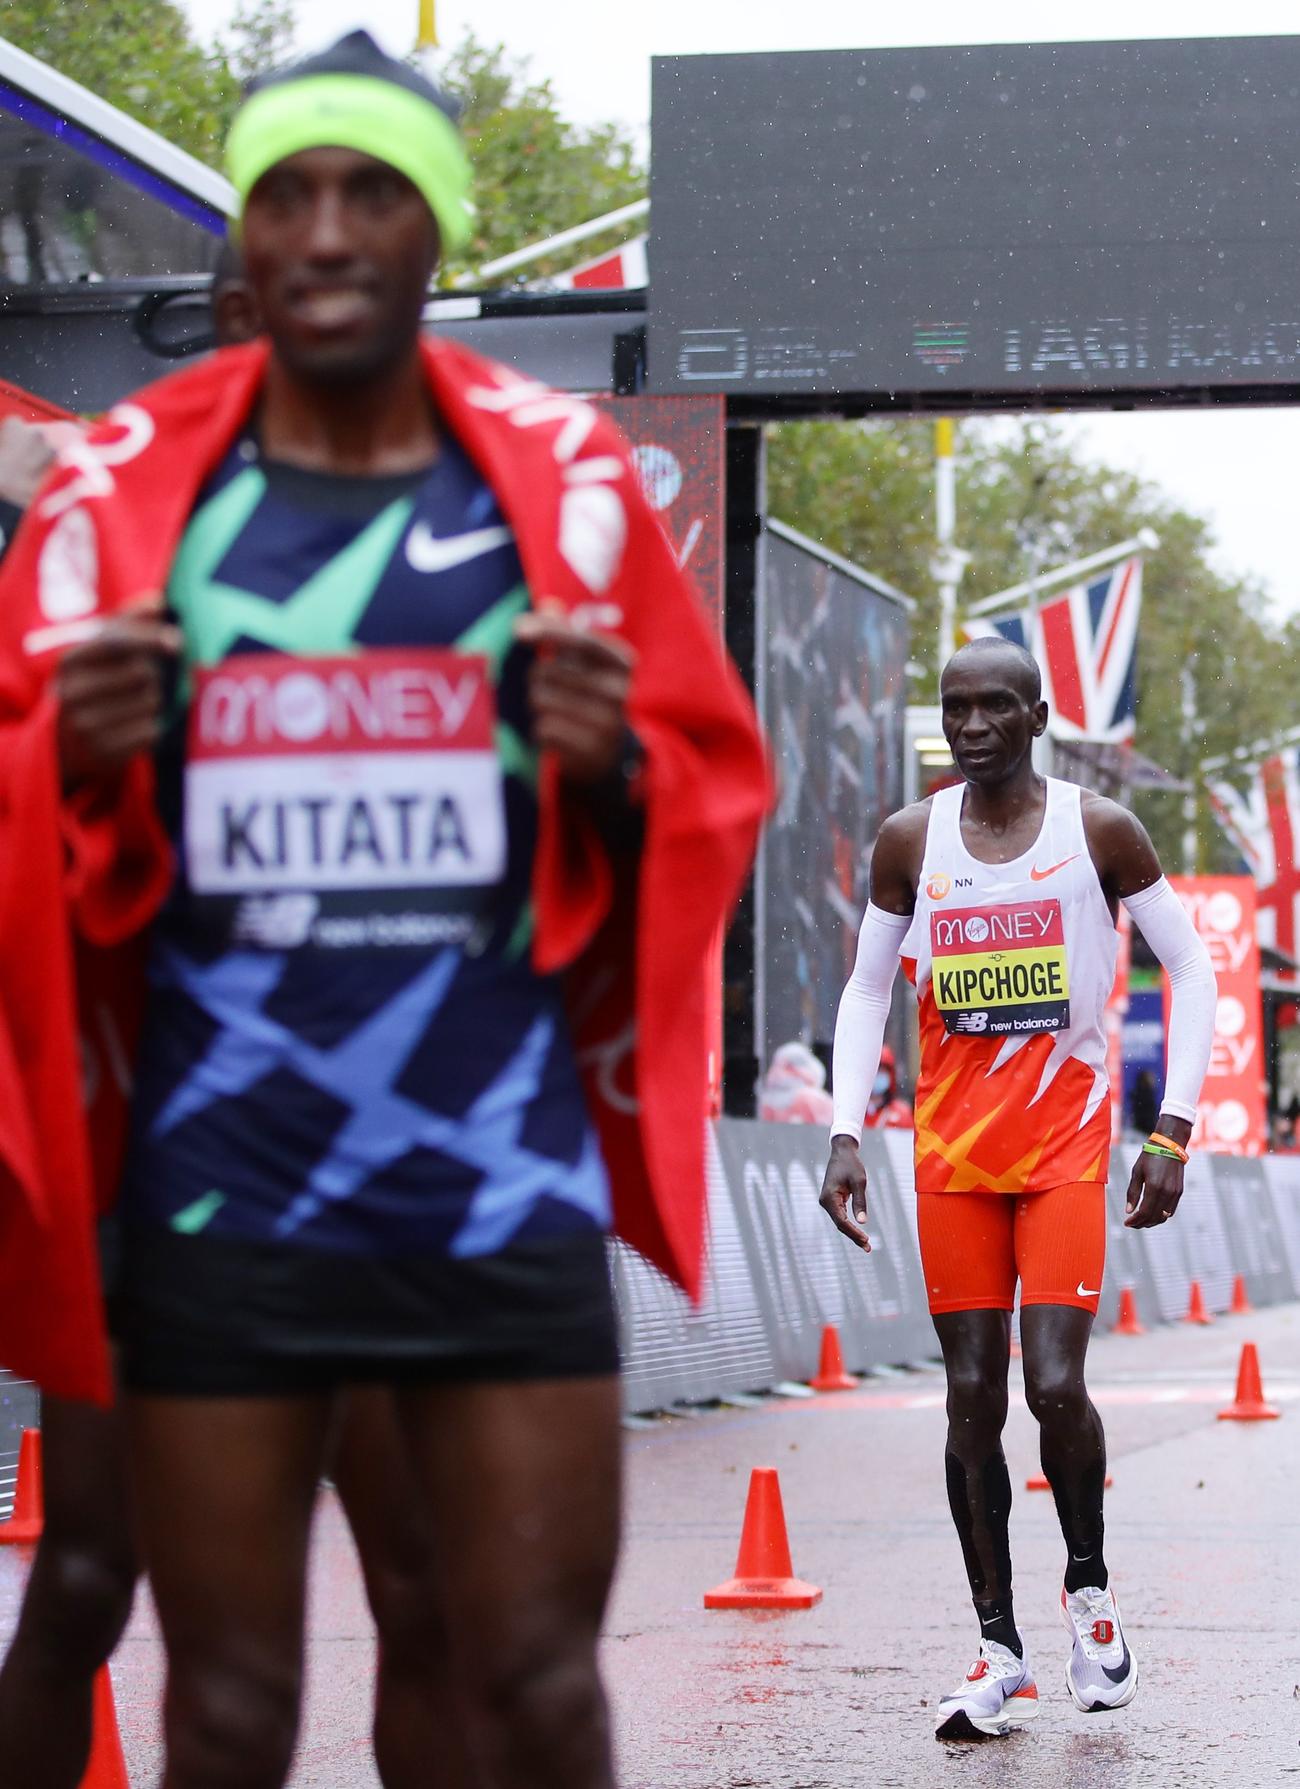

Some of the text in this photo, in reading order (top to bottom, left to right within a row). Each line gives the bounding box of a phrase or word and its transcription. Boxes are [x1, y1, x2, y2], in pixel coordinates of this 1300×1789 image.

[201, 669, 479, 746] MONEY
[221, 797, 471, 869] KITATA
[954, 877, 973, 888] NN
[936, 909, 1054, 946] MONEY
[939, 961, 1063, 1004] KIPCHOGE
[990, 1022, 1012, 1032] new
[1014, 1018, 1060, 1030] balance
